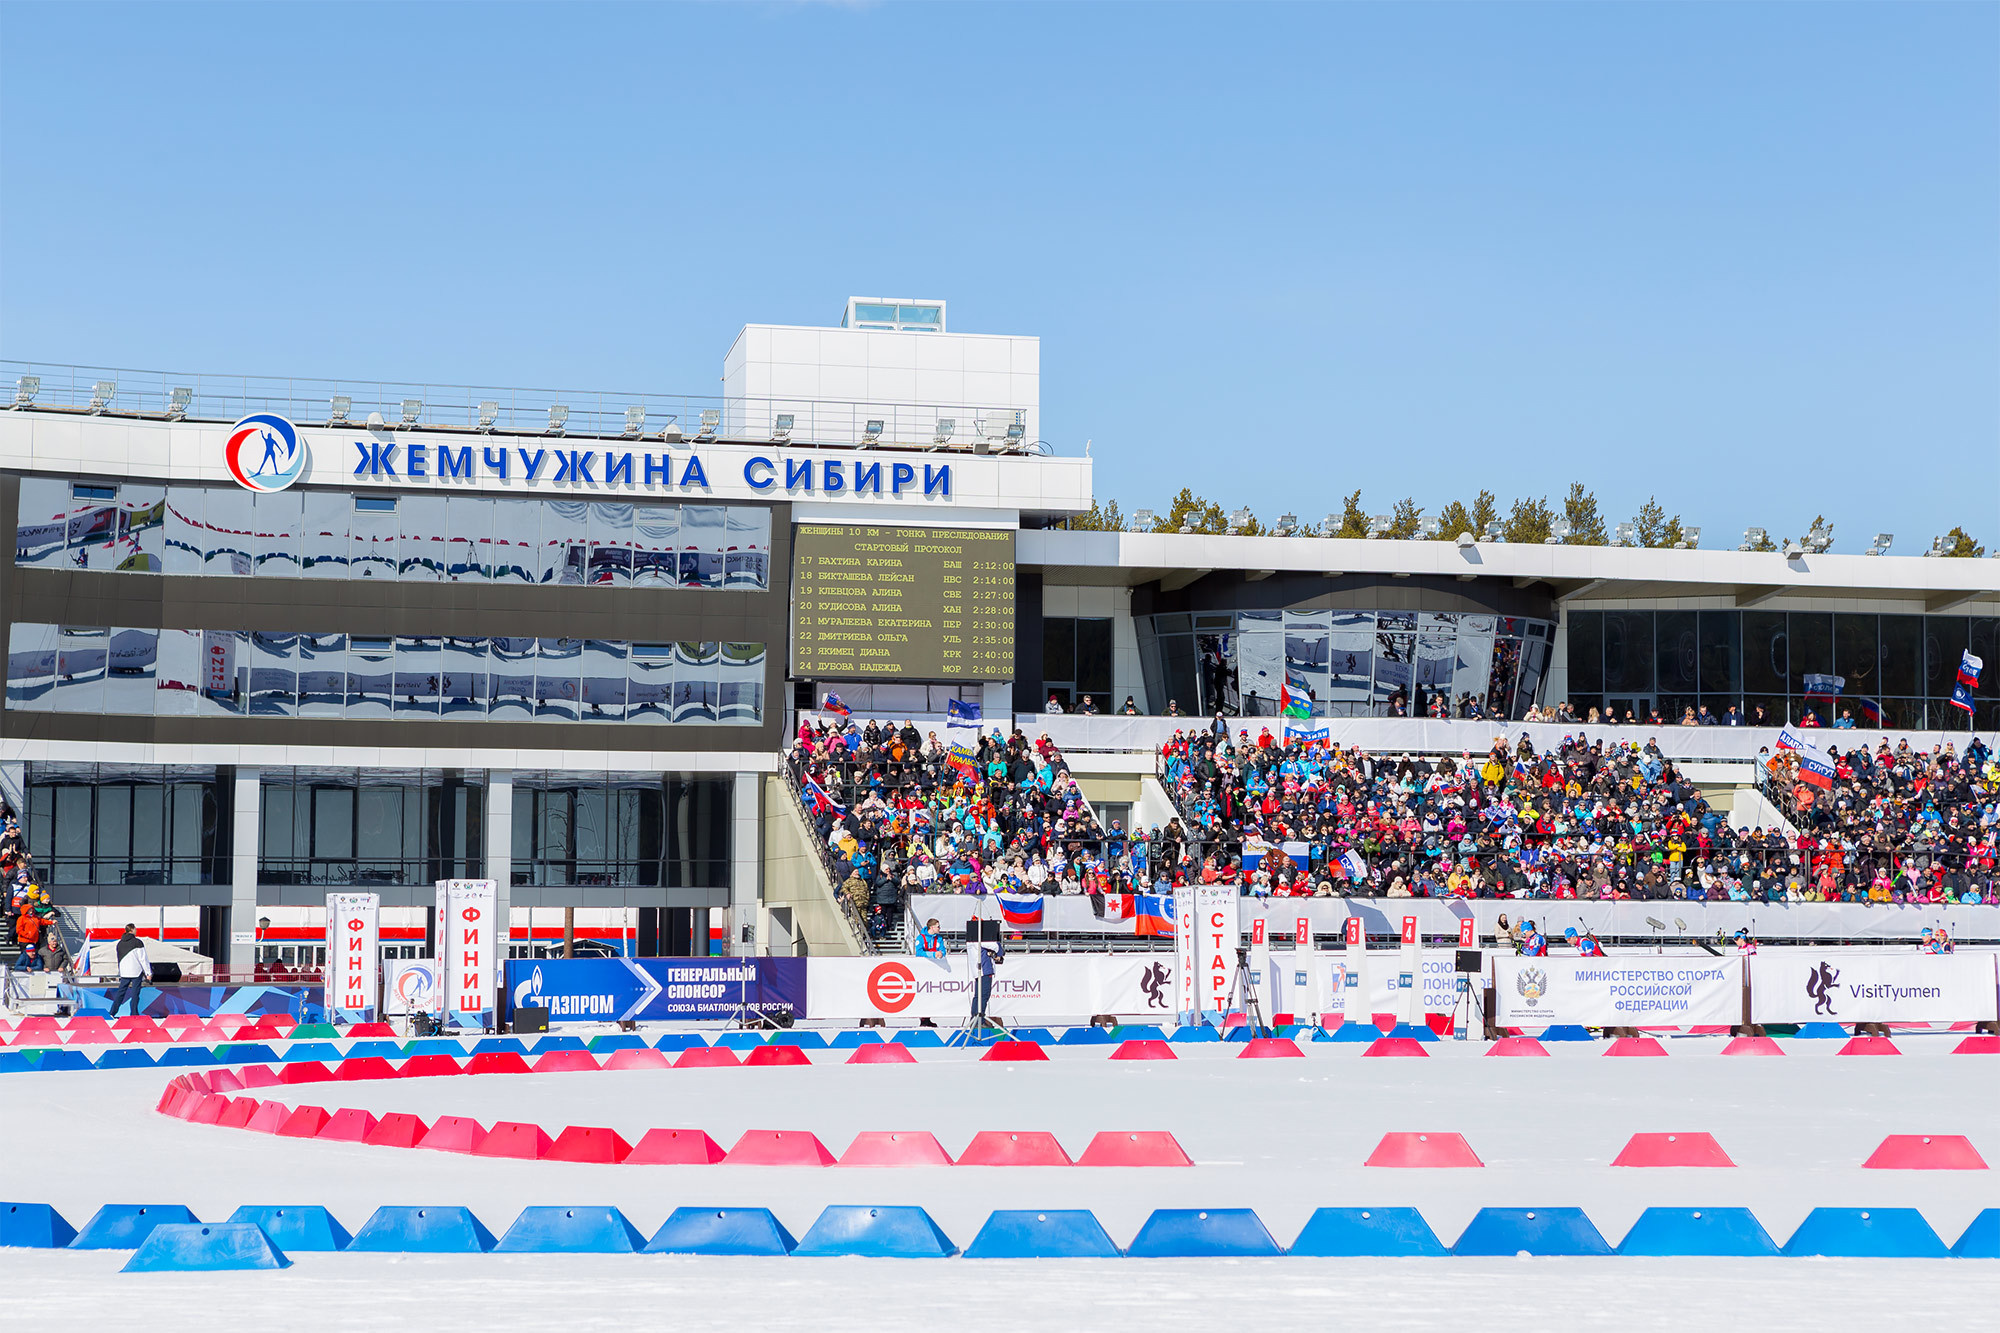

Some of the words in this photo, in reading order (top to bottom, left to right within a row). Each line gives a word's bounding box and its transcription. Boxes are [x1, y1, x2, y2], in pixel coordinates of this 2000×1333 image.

[354, 441, 709, 488] ЖЕМЧУЖИНА
[743, 456, 951, 496] СИБИРИ
[799, 527, 844, 536] ЖЕНЩИНЫ
[849, 528, 861, 536] 10
[866, 529, 880, 537] КМ
[896, 530, 927, 538] ГОНКА
[931, 531, 1009, 541] ПРЕСЛЕДОВАНИЯ
[854, 543, 909, 553] СТАРТОВЫЙ
[914, 545, 962, 554] ПРОТОКОЛ
[800, 557, 813, 565] 17
[818, 557, 861, 566] БАХТИНА
[866, 559, 903, 567] КАРИНА
[943, 561, 962, 569] БАШ
[972, 562, 1015, 571] 2:12:00
[800, 572, 813, 580] 18
[818, 572, 873, 581] БИКТАШЕВА
[877, 573, 915, 583] ЛЕЙСАН
[943, 576, 962, 584] НВС
[973, 577, 1015, 585] 2:14:00
[800, 587, 813, 595] 19
[818, 587, 867, 596] КЛЕВЦОВА
[871, 589, 903, 597] АЛИНА
[943, 591, 962, 599] СВЕ
[972, 592, 1015, 600] 2:27:00
[799, 602, 813, 610] 20
[818, 603, 867, 611] КУДИСОВА
[871, 604, 903, 612] АЛИНА
[943, 606, 962, 614] ХАН
[972, 606, 1015, 615] 2:28:00
[799, 617, 812, 625] 21
[817, 618, 873, 627] МУРАЛЕЕВА
[877, 619, 932, 628] ЕКАТЕРИНА
[943, 621, 962, 629] ПЕР
[972, 621, 1015, 630] 2:30:00
[799, 632, 812, 640] 22
[817, 633, 873, 641] ДМИТРИЕВА
[877, 634, 909, 642] ОЛЬГА
[972, 636, 1014, 645] 2:35:00
[799, 647, 812, 655] 23
[817, 648, 855, 657] ЯКИМЕЦ
[859, 649, 891, 657] ДИАНА
[972, 651, 1014, 660] 2:40:00
[799, 662, 812, 670] 24
[817, 663, 855, 671] ДУБОВА
[859, 664, 903, 673] НАДЕЖДА
[972, 666, 1014, 675] 2:40:00
[1256, 927, 1261, 941] 1
[1300, 927, 1305, 941] 2
[1351, 927, 1356, 941] 3
[1405, 925, 1412, 940] 4
[1462, 928, 1470, 944] R
[345, 918, 365, 1009] ФИНИШ
[460, 907, 482, 1012] ФИНИШ
[1183, 913, 1192, 1014] СТАРТ
[1210, 912, 1226, 1013] СТАРТ
[667, 964, 756, 982] ГЕНЕРАЛЬНЫЙ
[1421, 962, 1457, 974] СОЮ
[1575, 970, 1674, 981] МИНИСТЕРСТВО
[1677, 970, 1725, 981] СПОРТА
[667, 984, 726, 999] СПОНСОР
[916, 979, 1041, 993] ИНФИИТУМ
[1609, 983, 1692, 996] РОССИЙСКОЙ
[1849, 983, 1941, 1002] VisitTyumen
[544, 994, 614, 1015] ГАЗПРОМ
[667, 1003, 696, 1013] СОЮЗА
[762, 1002, 794, 1011] РОССИИ
[1614, 1000, 1689, 1012] ФЕДЕРАЦИИ
